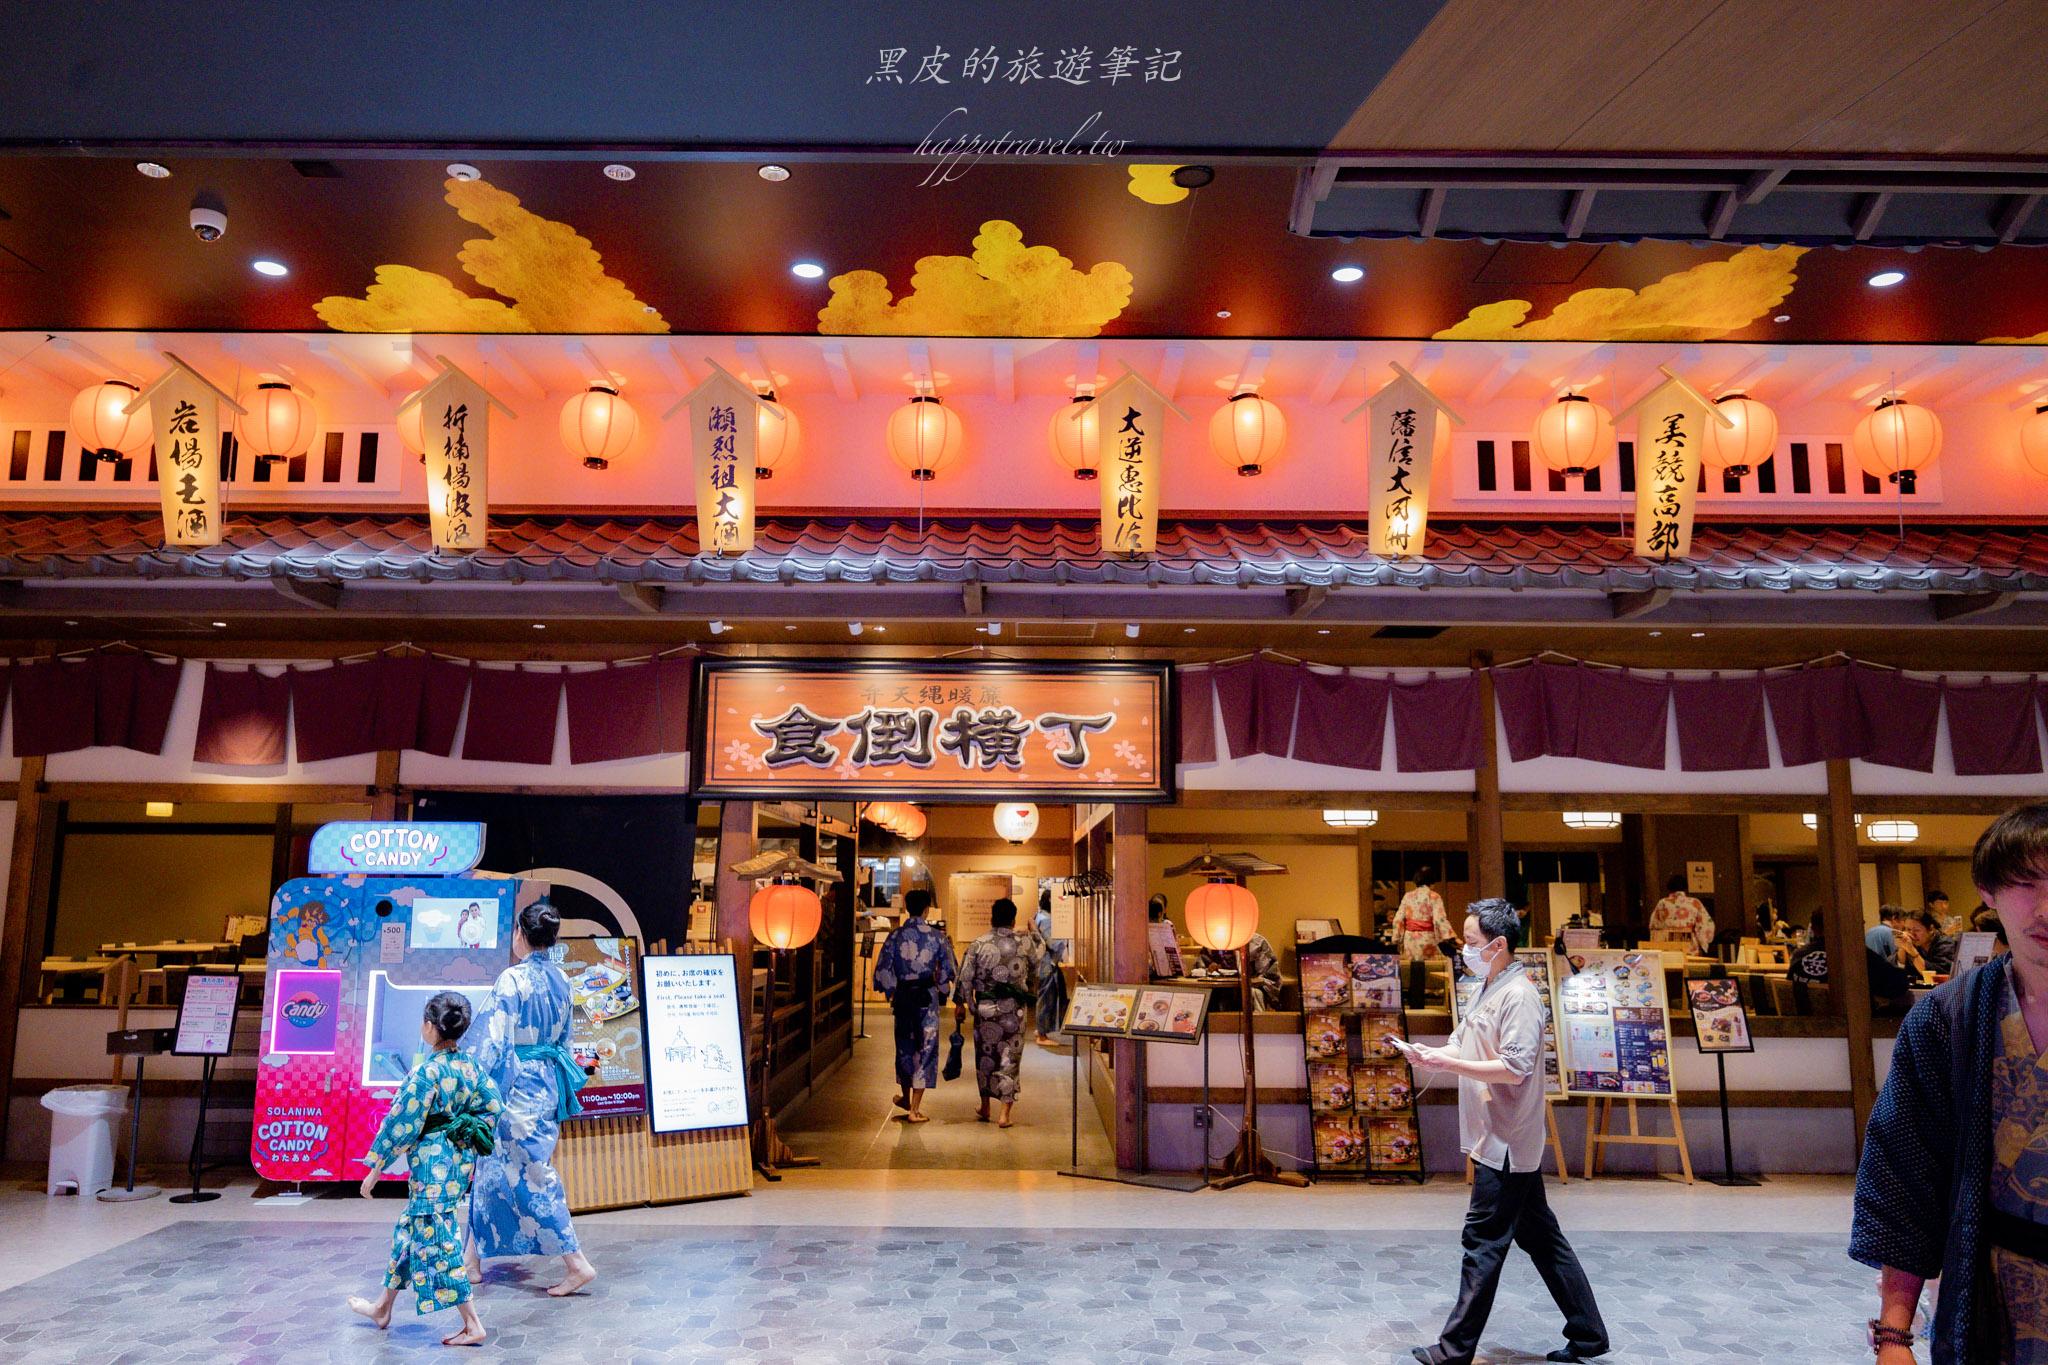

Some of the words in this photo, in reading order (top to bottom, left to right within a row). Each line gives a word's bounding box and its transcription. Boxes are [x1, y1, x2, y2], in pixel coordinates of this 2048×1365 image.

[753, 705, 1114, 769] 食倒横丁
[350, 828, 440, 854] COTTON
[365, 851, 422, 866] CANDY
[281, 1001, 329, 1019] Candy
[267, 1107, 323, 1117] SOLANIWA
[258, 1121, 329, 1142] COTTON
[269, 1139, 315, 1152] CANDY
[271, 1153, 310, 1162] わたあめ
